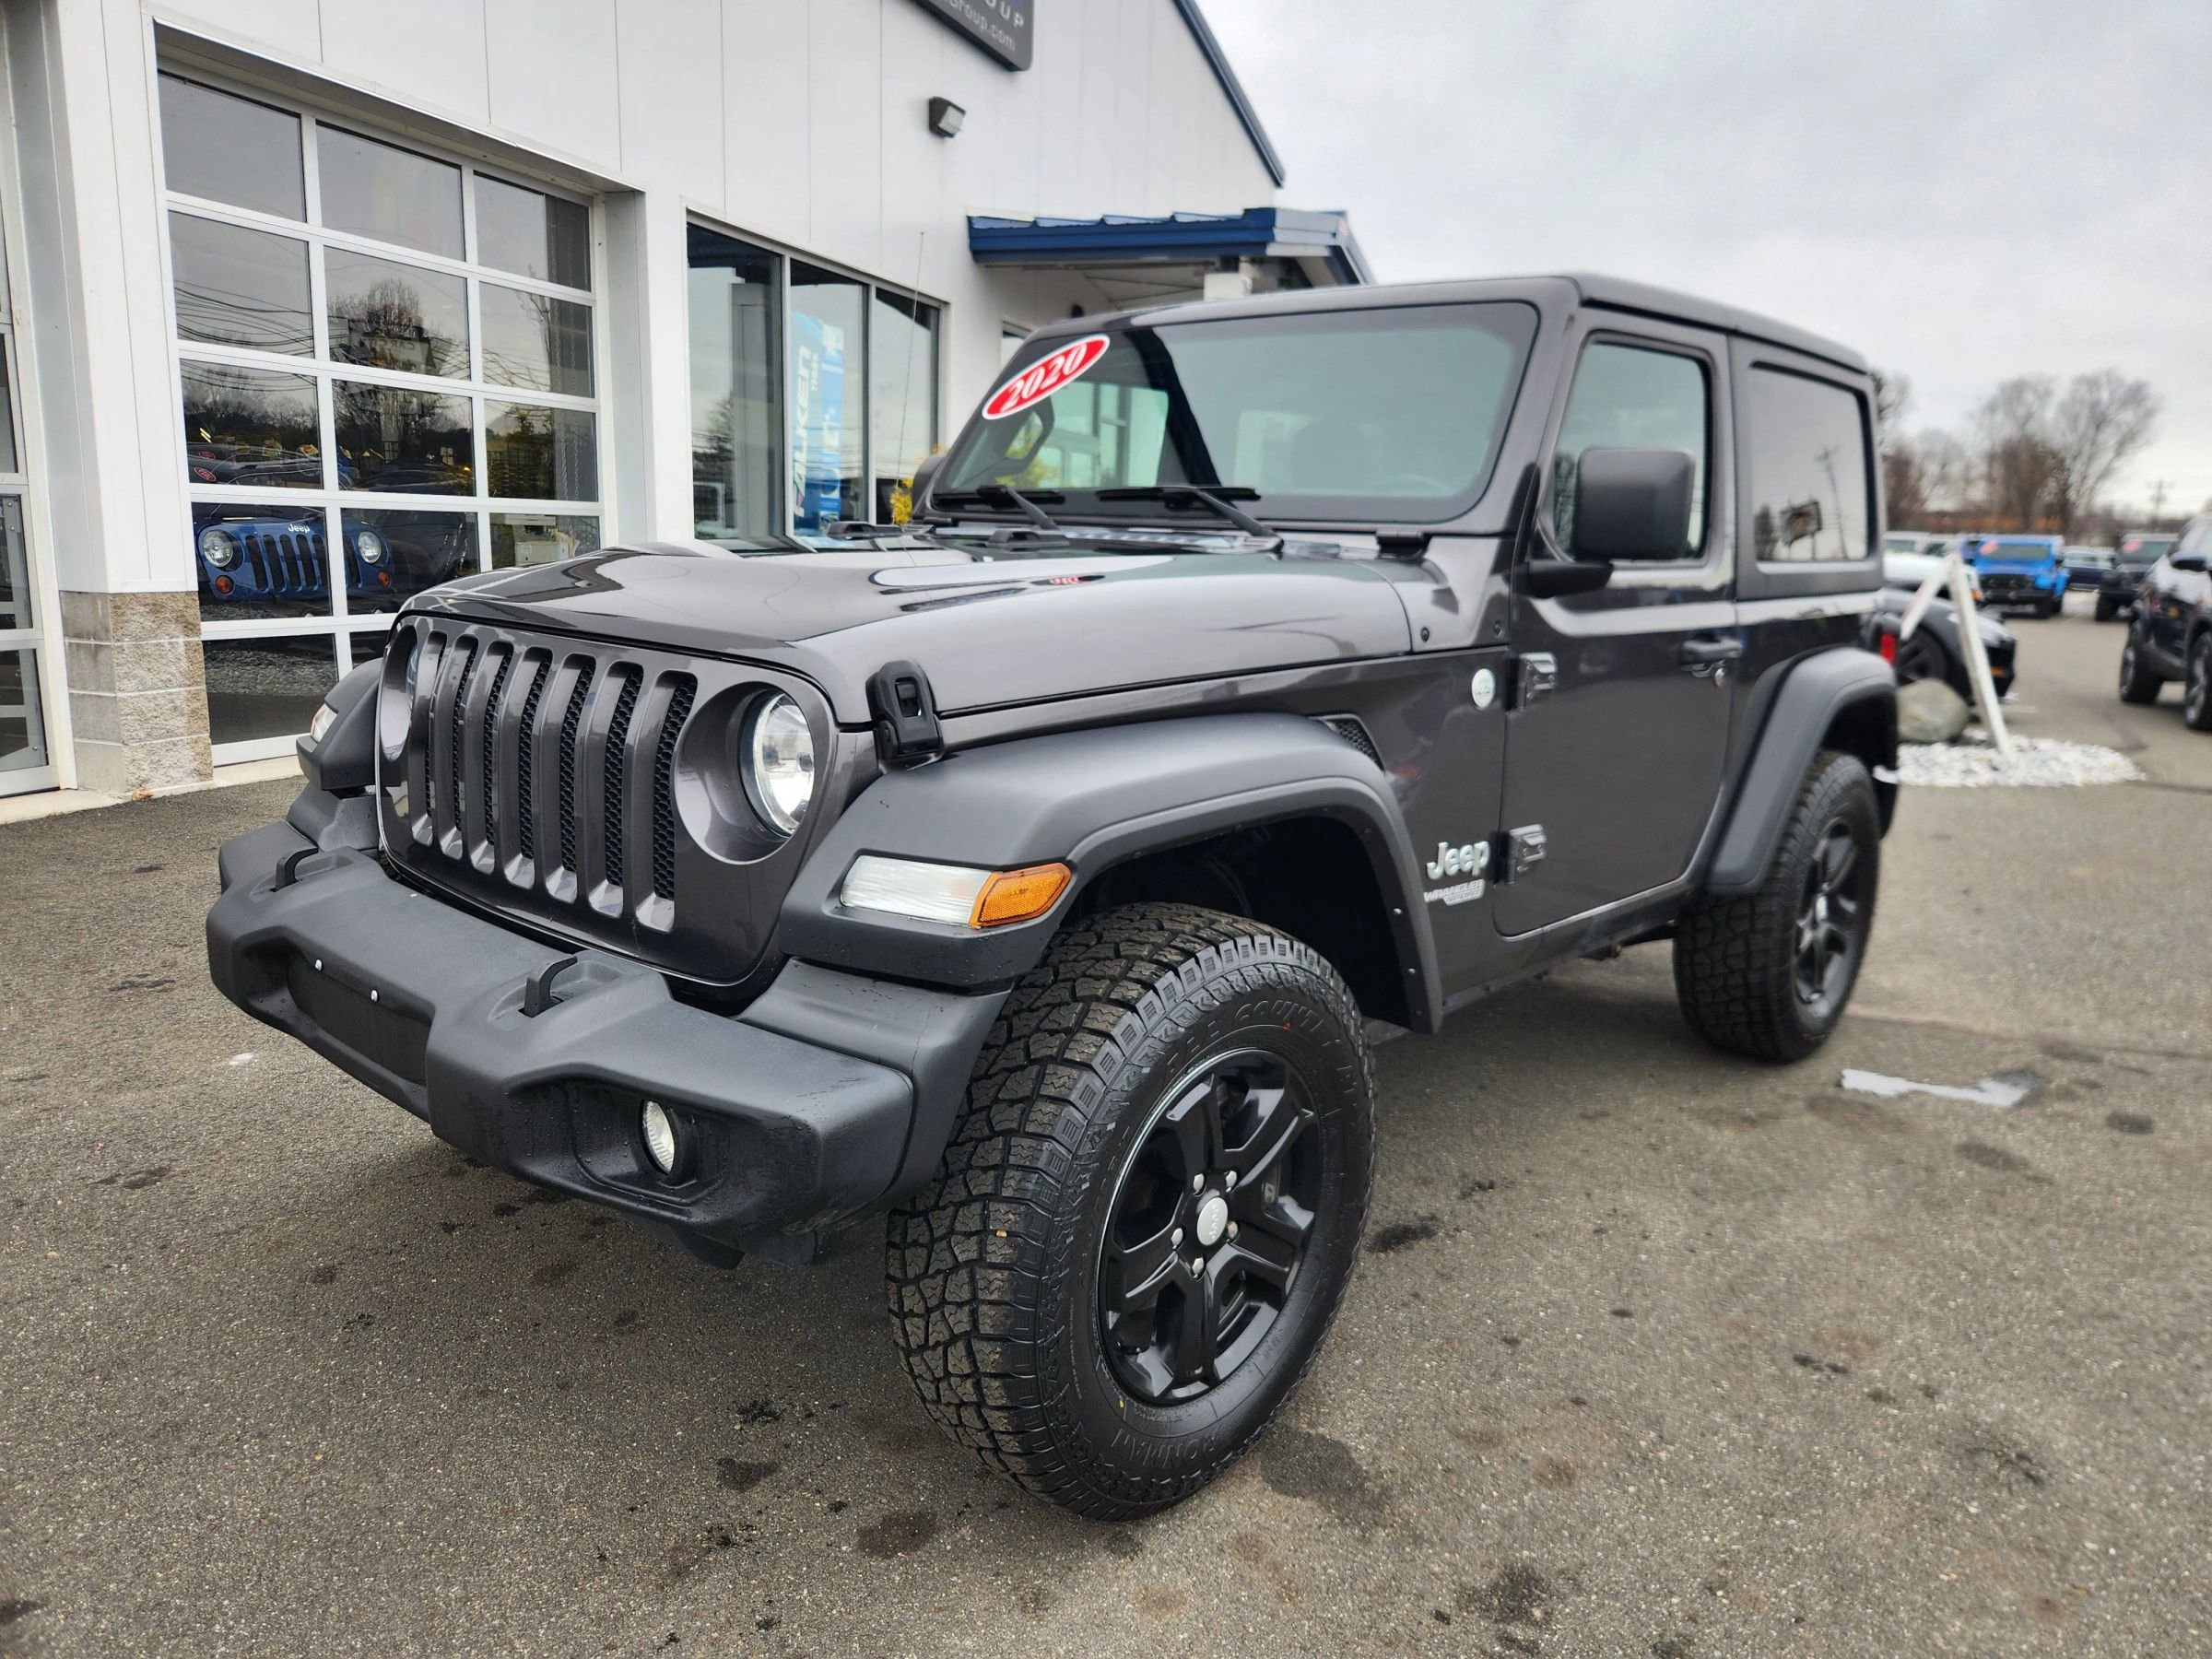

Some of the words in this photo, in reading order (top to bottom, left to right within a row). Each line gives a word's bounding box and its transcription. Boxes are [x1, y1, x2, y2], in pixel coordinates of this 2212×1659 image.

[1000, 343, 1088, 414] 2020
[288, 524, 311, 534] Jeep
[1426, 841, 1490, 880] Jeep
